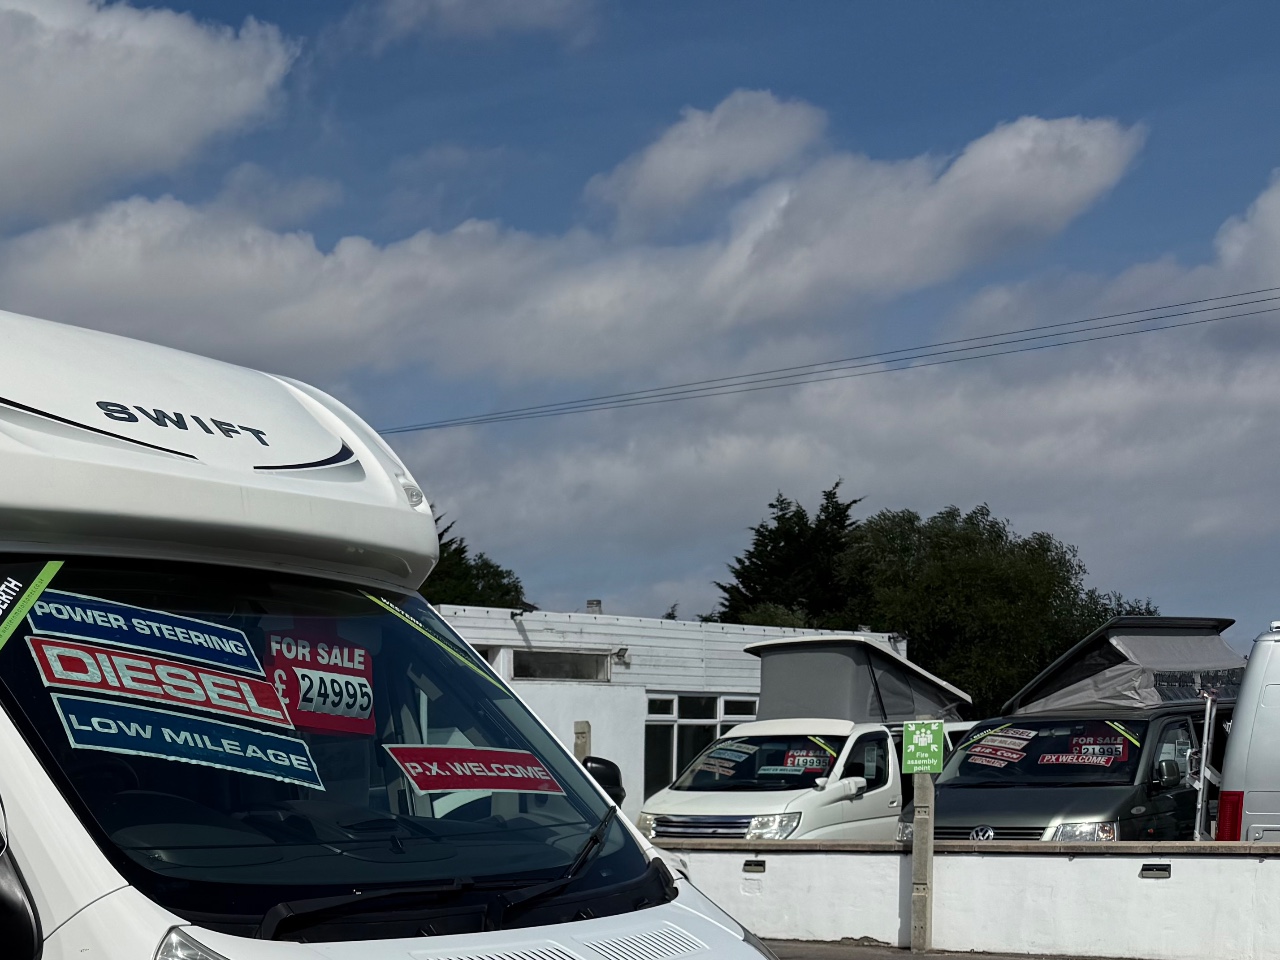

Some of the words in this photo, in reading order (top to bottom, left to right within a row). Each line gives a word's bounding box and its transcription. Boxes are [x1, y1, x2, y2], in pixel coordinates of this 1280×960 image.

[96, 401, 269, 447] SWIFT
[34, 600, 128, 631] POWER
[131, 618, 248, 657] STEERING
[270, 634, 311, 662] FOR
[316, 642, 366, 671] SALE
[41, 644, 285, 720] DIESEL
[273, 669, 290, 704] £
[299, 673, 372, 712] 24995
[68, 713, 153, 739] LOW
[161, 727, 313, 772] MILEAGE
[788, 749, 807, 757] FOR
[1072, 736, 1094, 744] FOR
[1096, 736, 1124, 744] SALE
[404, 761, 452, 777] P.X.
[446, 761, 552, 780] WELCOME
[907, 758, 938, 766] assembly
[913, 765, 931, 773] point
[1043, 754, 1058, 763] PX
[1059, 754, 1108, 765] WELCOME
